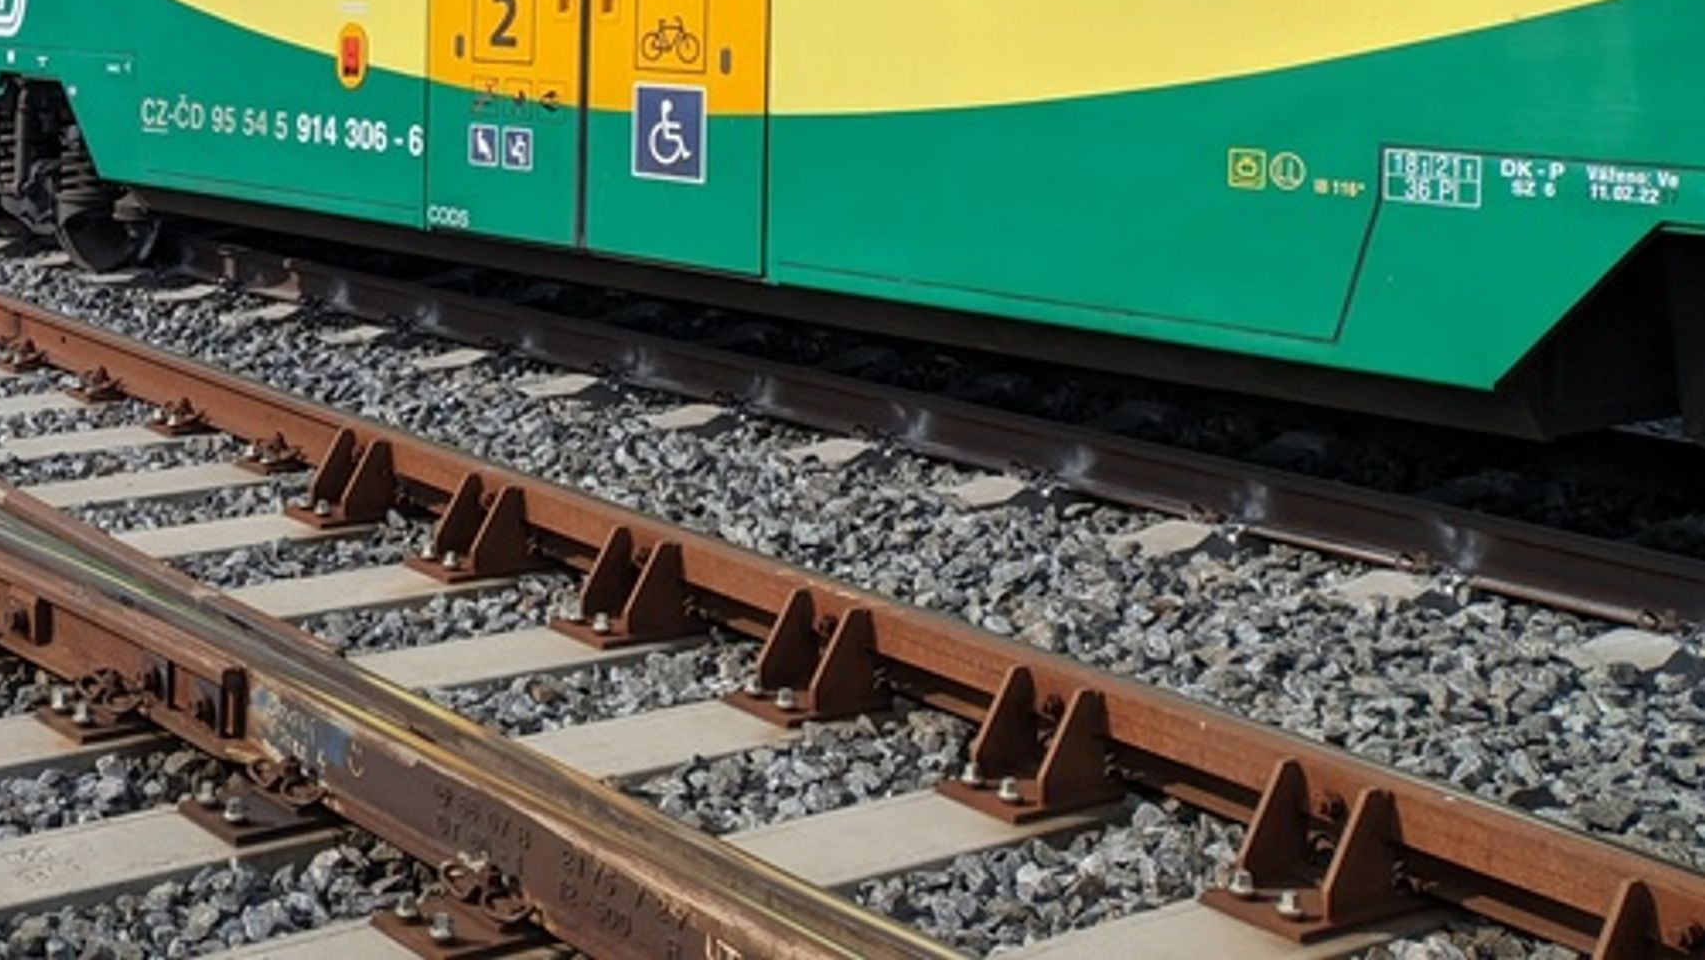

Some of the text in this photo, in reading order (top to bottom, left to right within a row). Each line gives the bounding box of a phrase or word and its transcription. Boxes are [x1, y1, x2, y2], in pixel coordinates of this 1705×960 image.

[141, 94, 206, 132] CZ-ČD
[211, 105, 237, 134] 95
[242, 107, 268, 137] 54
[273, 110, 289, 140] 5
[296, 112, 338, 146] 914
[345, 117, 389, 153] 306
[409, 124, 424, 157] 6
[1405, 176, 1430, 200] 36
